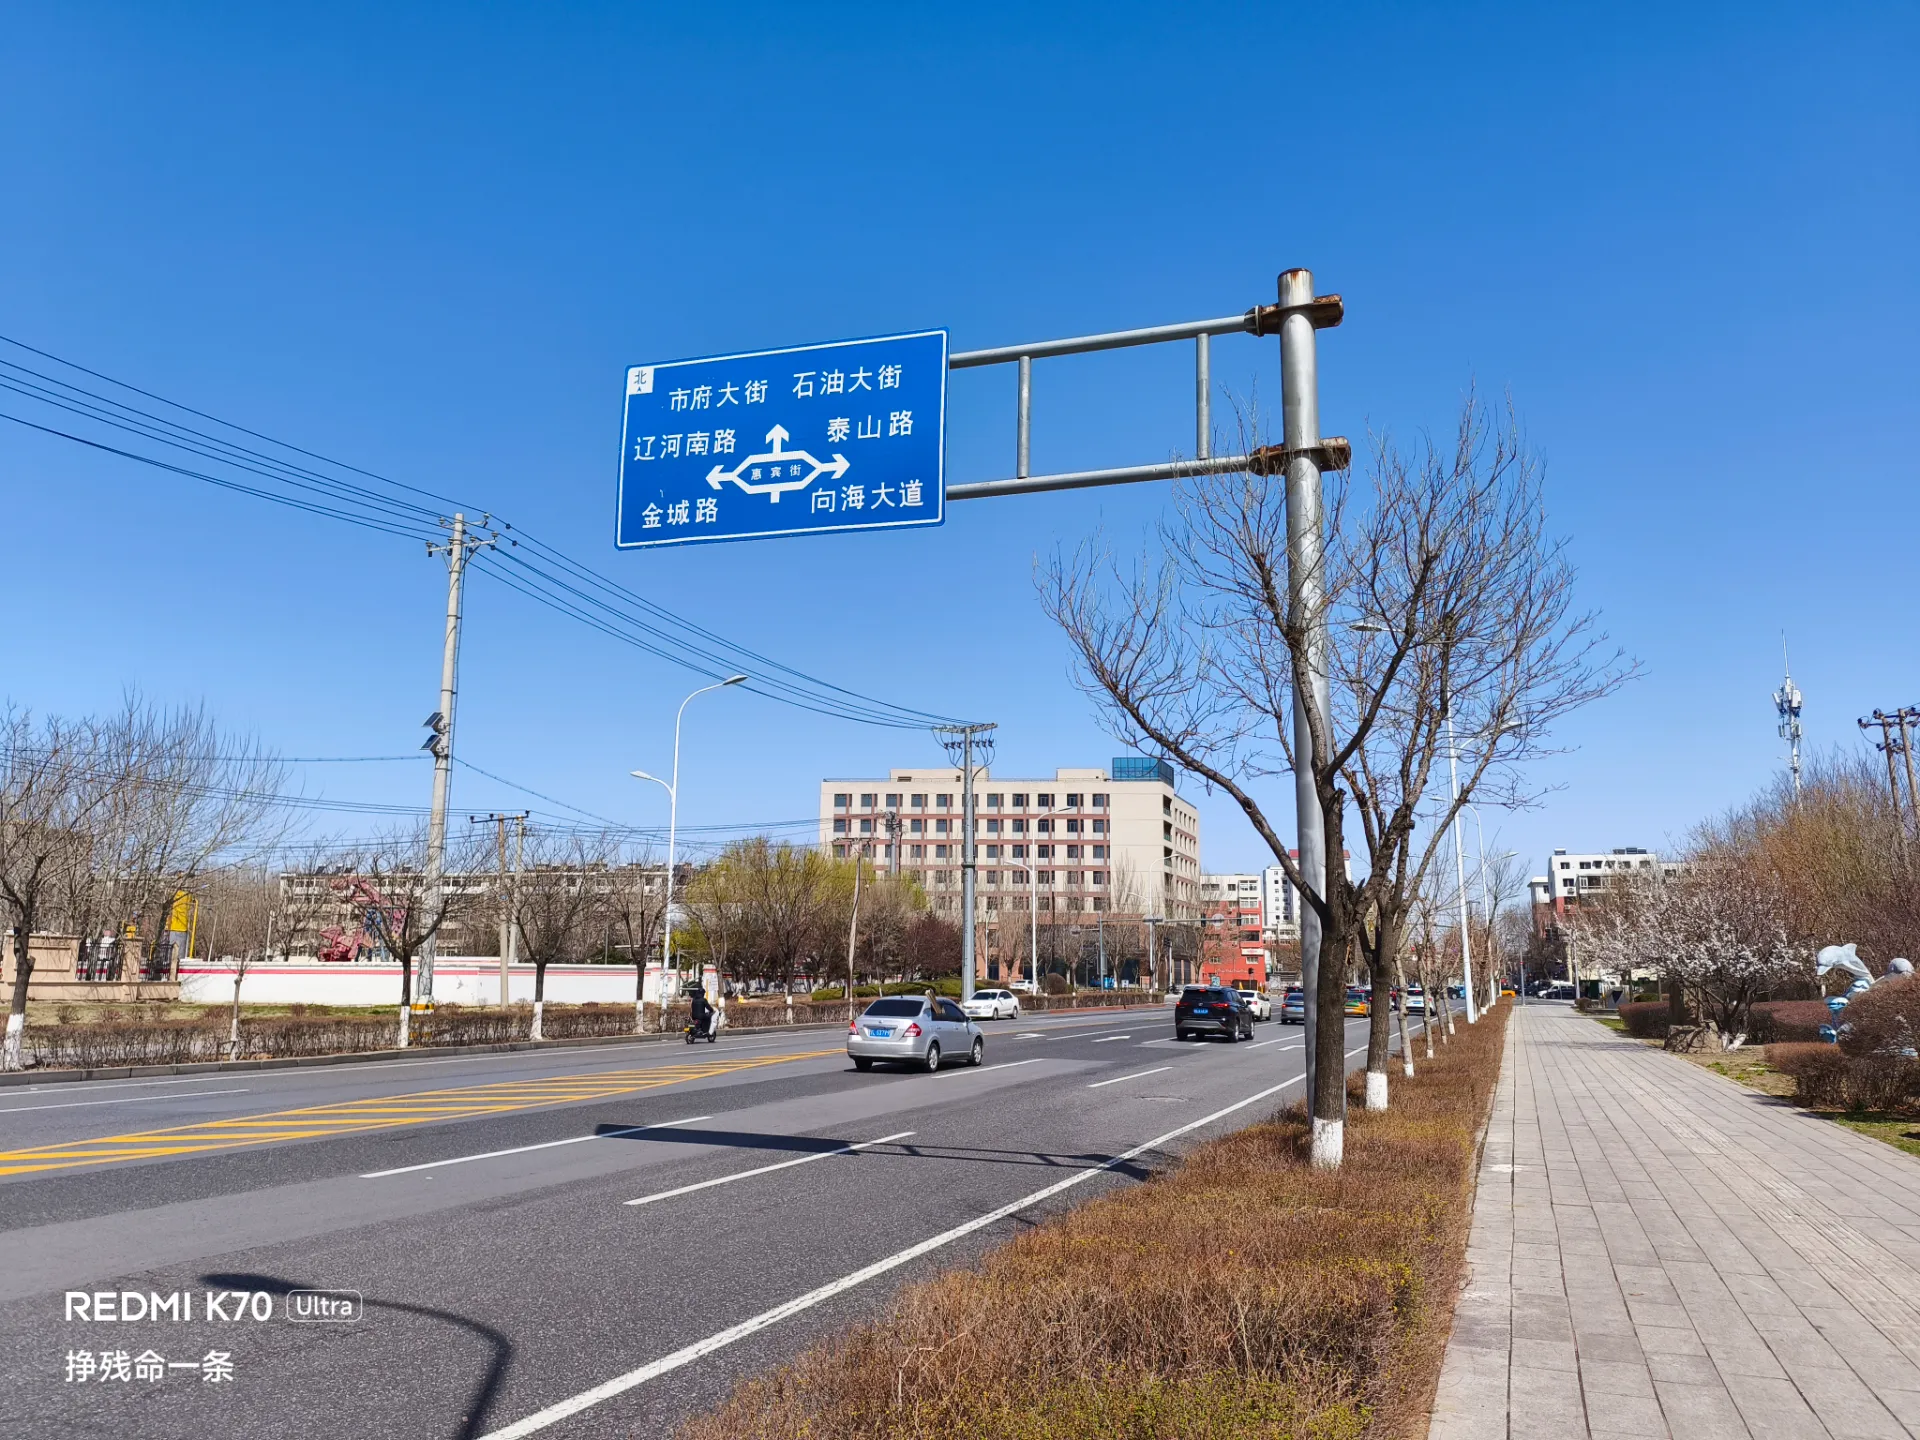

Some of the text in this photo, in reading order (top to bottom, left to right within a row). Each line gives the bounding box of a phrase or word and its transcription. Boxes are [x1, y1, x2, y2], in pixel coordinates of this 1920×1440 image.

[633, 369, 647, 384] 北
[792, 364, 902, 399] 石油大街
[668, 379, 769, 412] 市府大街
[827, 409, 913, 443] 泰山路
[633, 428, 737, 461] 辽河南路
[750, 464, 802, 480] 惠宾街
[641, 496, 718, 529] 金城路
[811, 478, 924, 514] 向海大道
